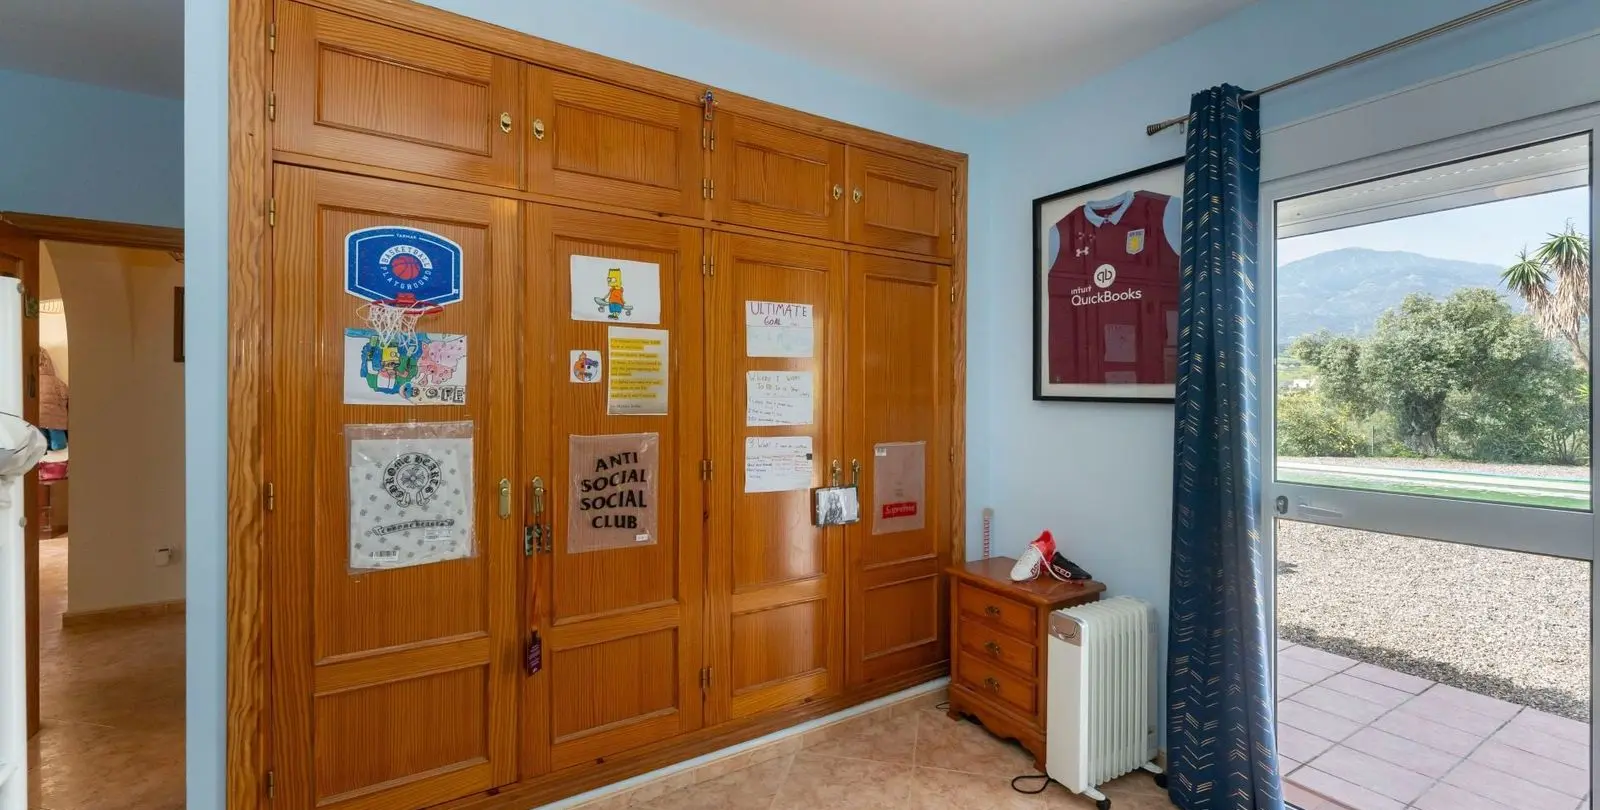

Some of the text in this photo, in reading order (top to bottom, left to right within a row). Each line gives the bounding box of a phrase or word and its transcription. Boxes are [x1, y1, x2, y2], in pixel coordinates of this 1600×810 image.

[381, 246, 432, 268] BASKETBALL
[381, 266, 432, 290] PLAYGROUND
[1071, 285, 1092, 295] intuit
[1071, 288, 1142, 306] QuickBooks
[750, 302, 807, 318] ULTIMATE
[595, 452, 638, 472] ANTI
[580, 469, 647, 493] SOCIAL
[580, 490, 647, 511] SOCIAL
[591, 515, 638, 529] CLUB
